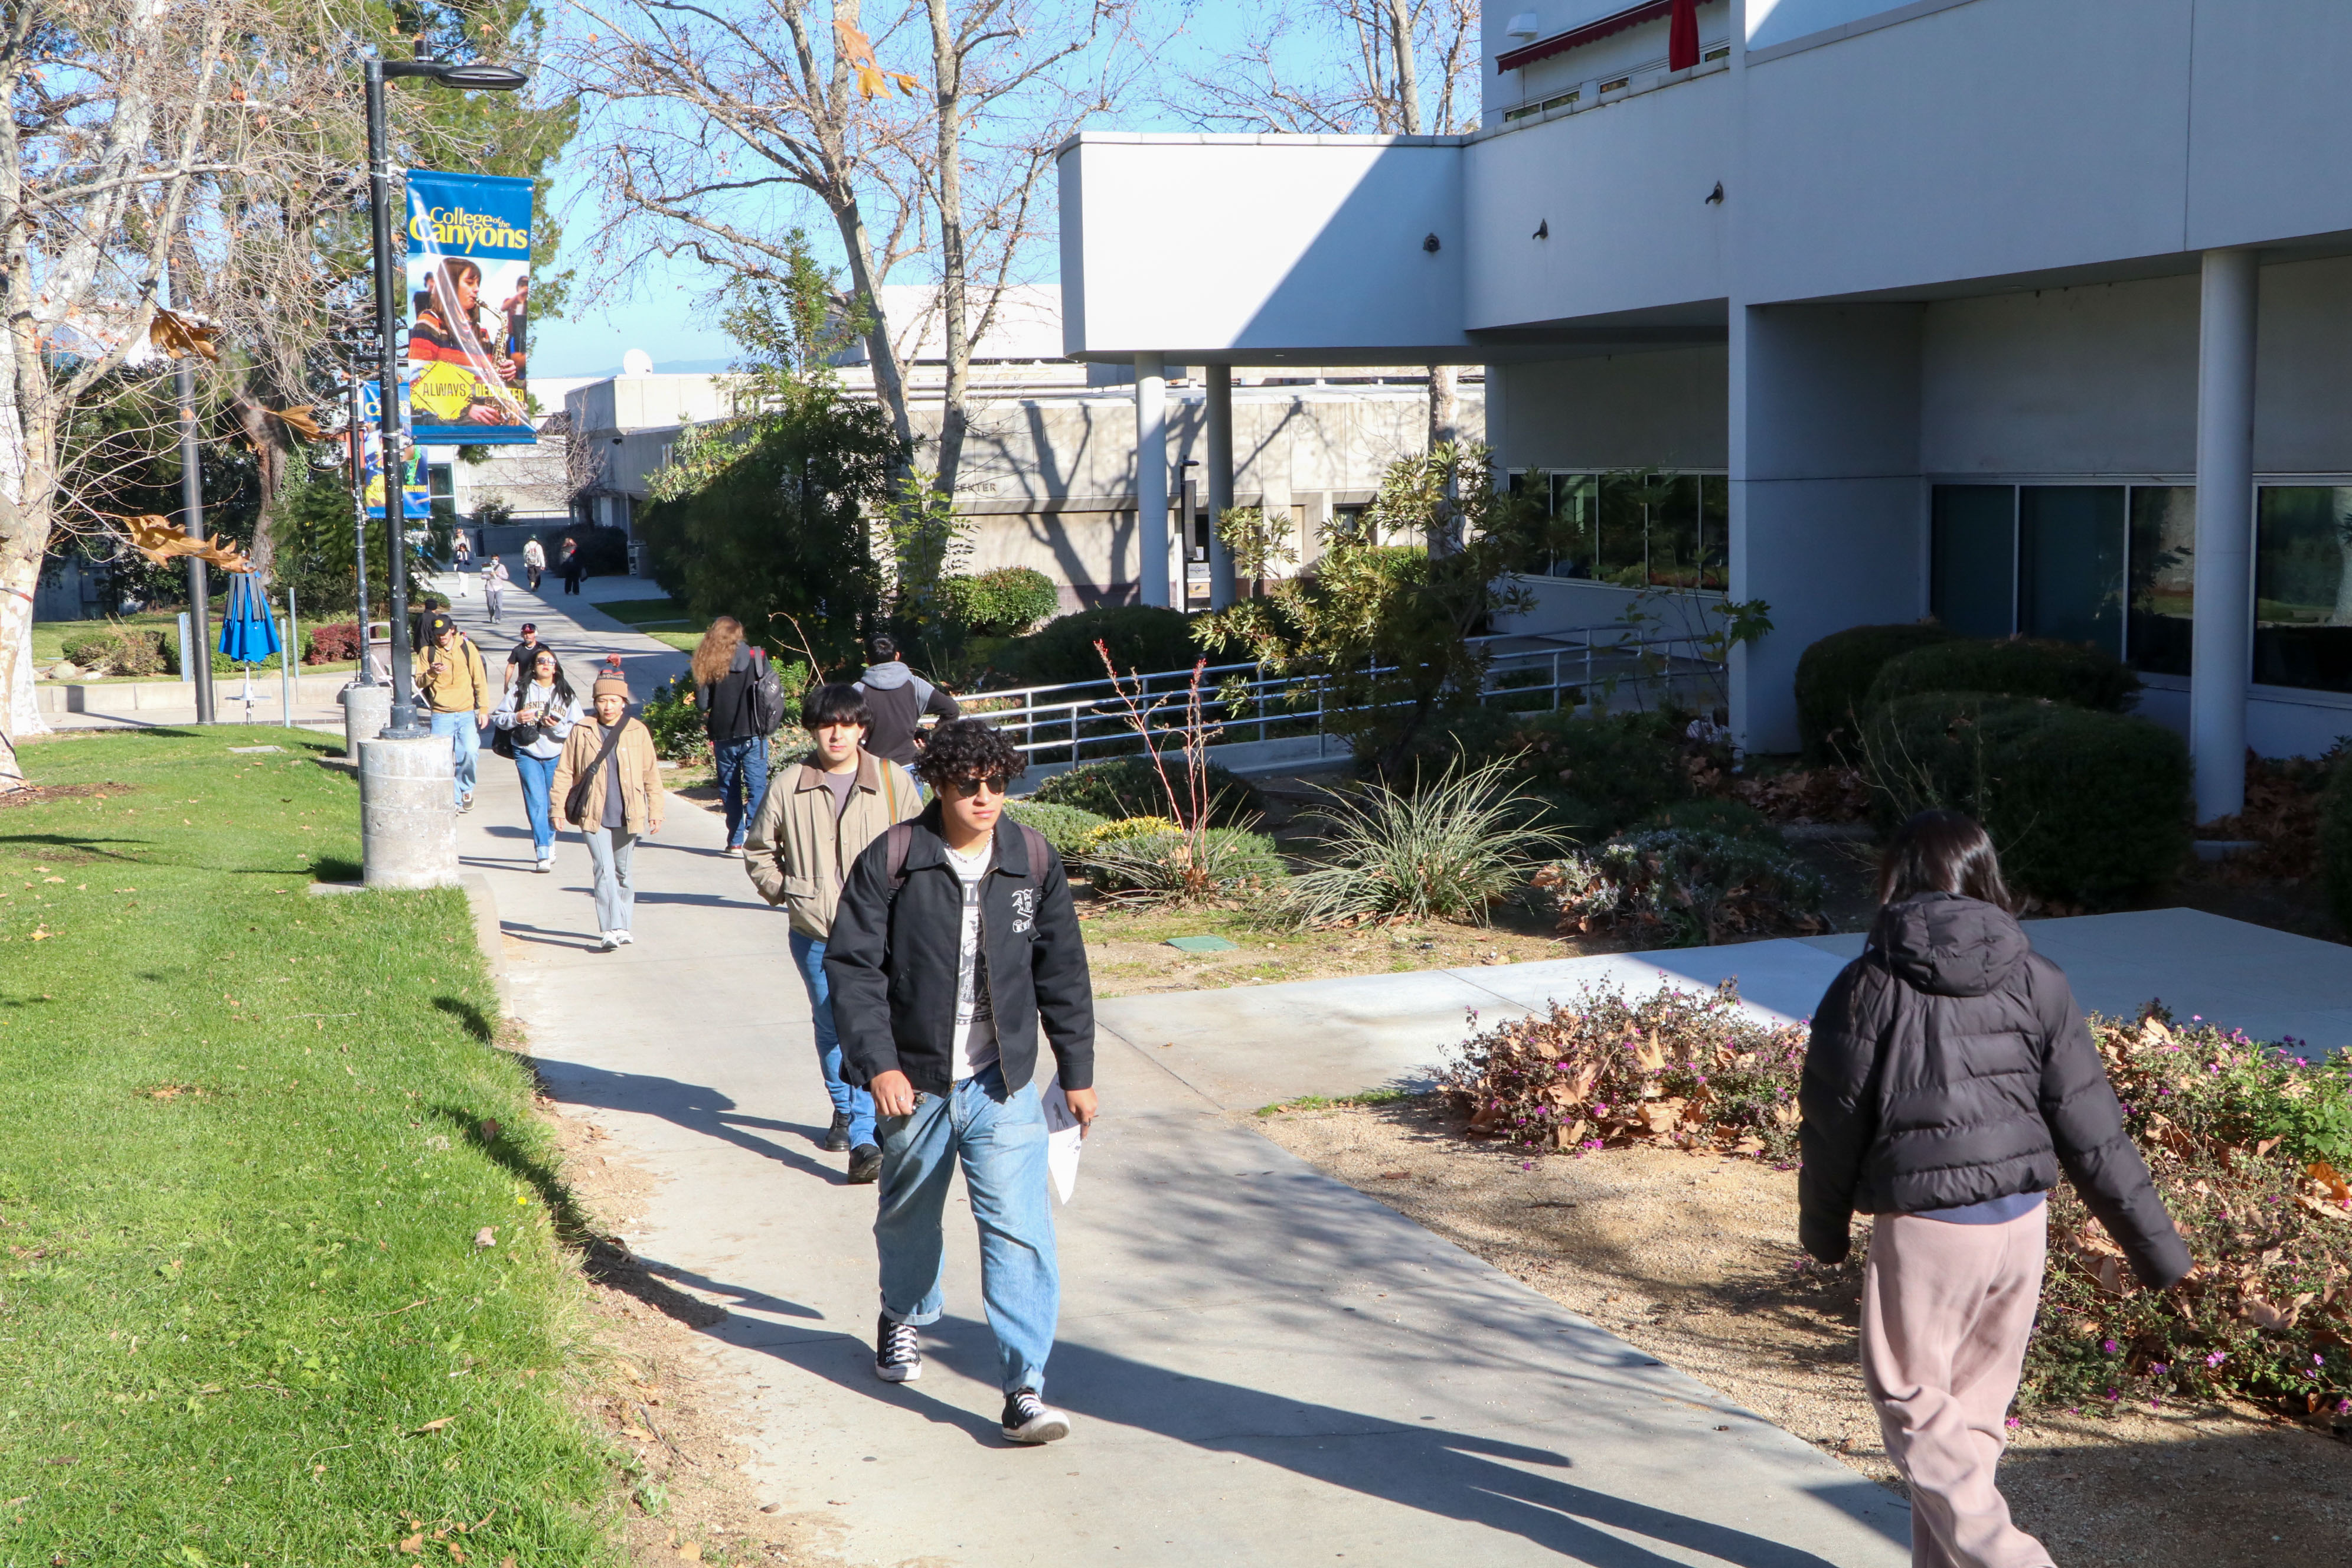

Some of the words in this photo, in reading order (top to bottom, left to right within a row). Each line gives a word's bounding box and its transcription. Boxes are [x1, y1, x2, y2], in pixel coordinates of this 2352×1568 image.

[430, 207, 493, 232] College
[498, 220, 511, 228] the
[409, 214, 528, 254] Canyons
[423, 383, 466, 397] ALWAYS
